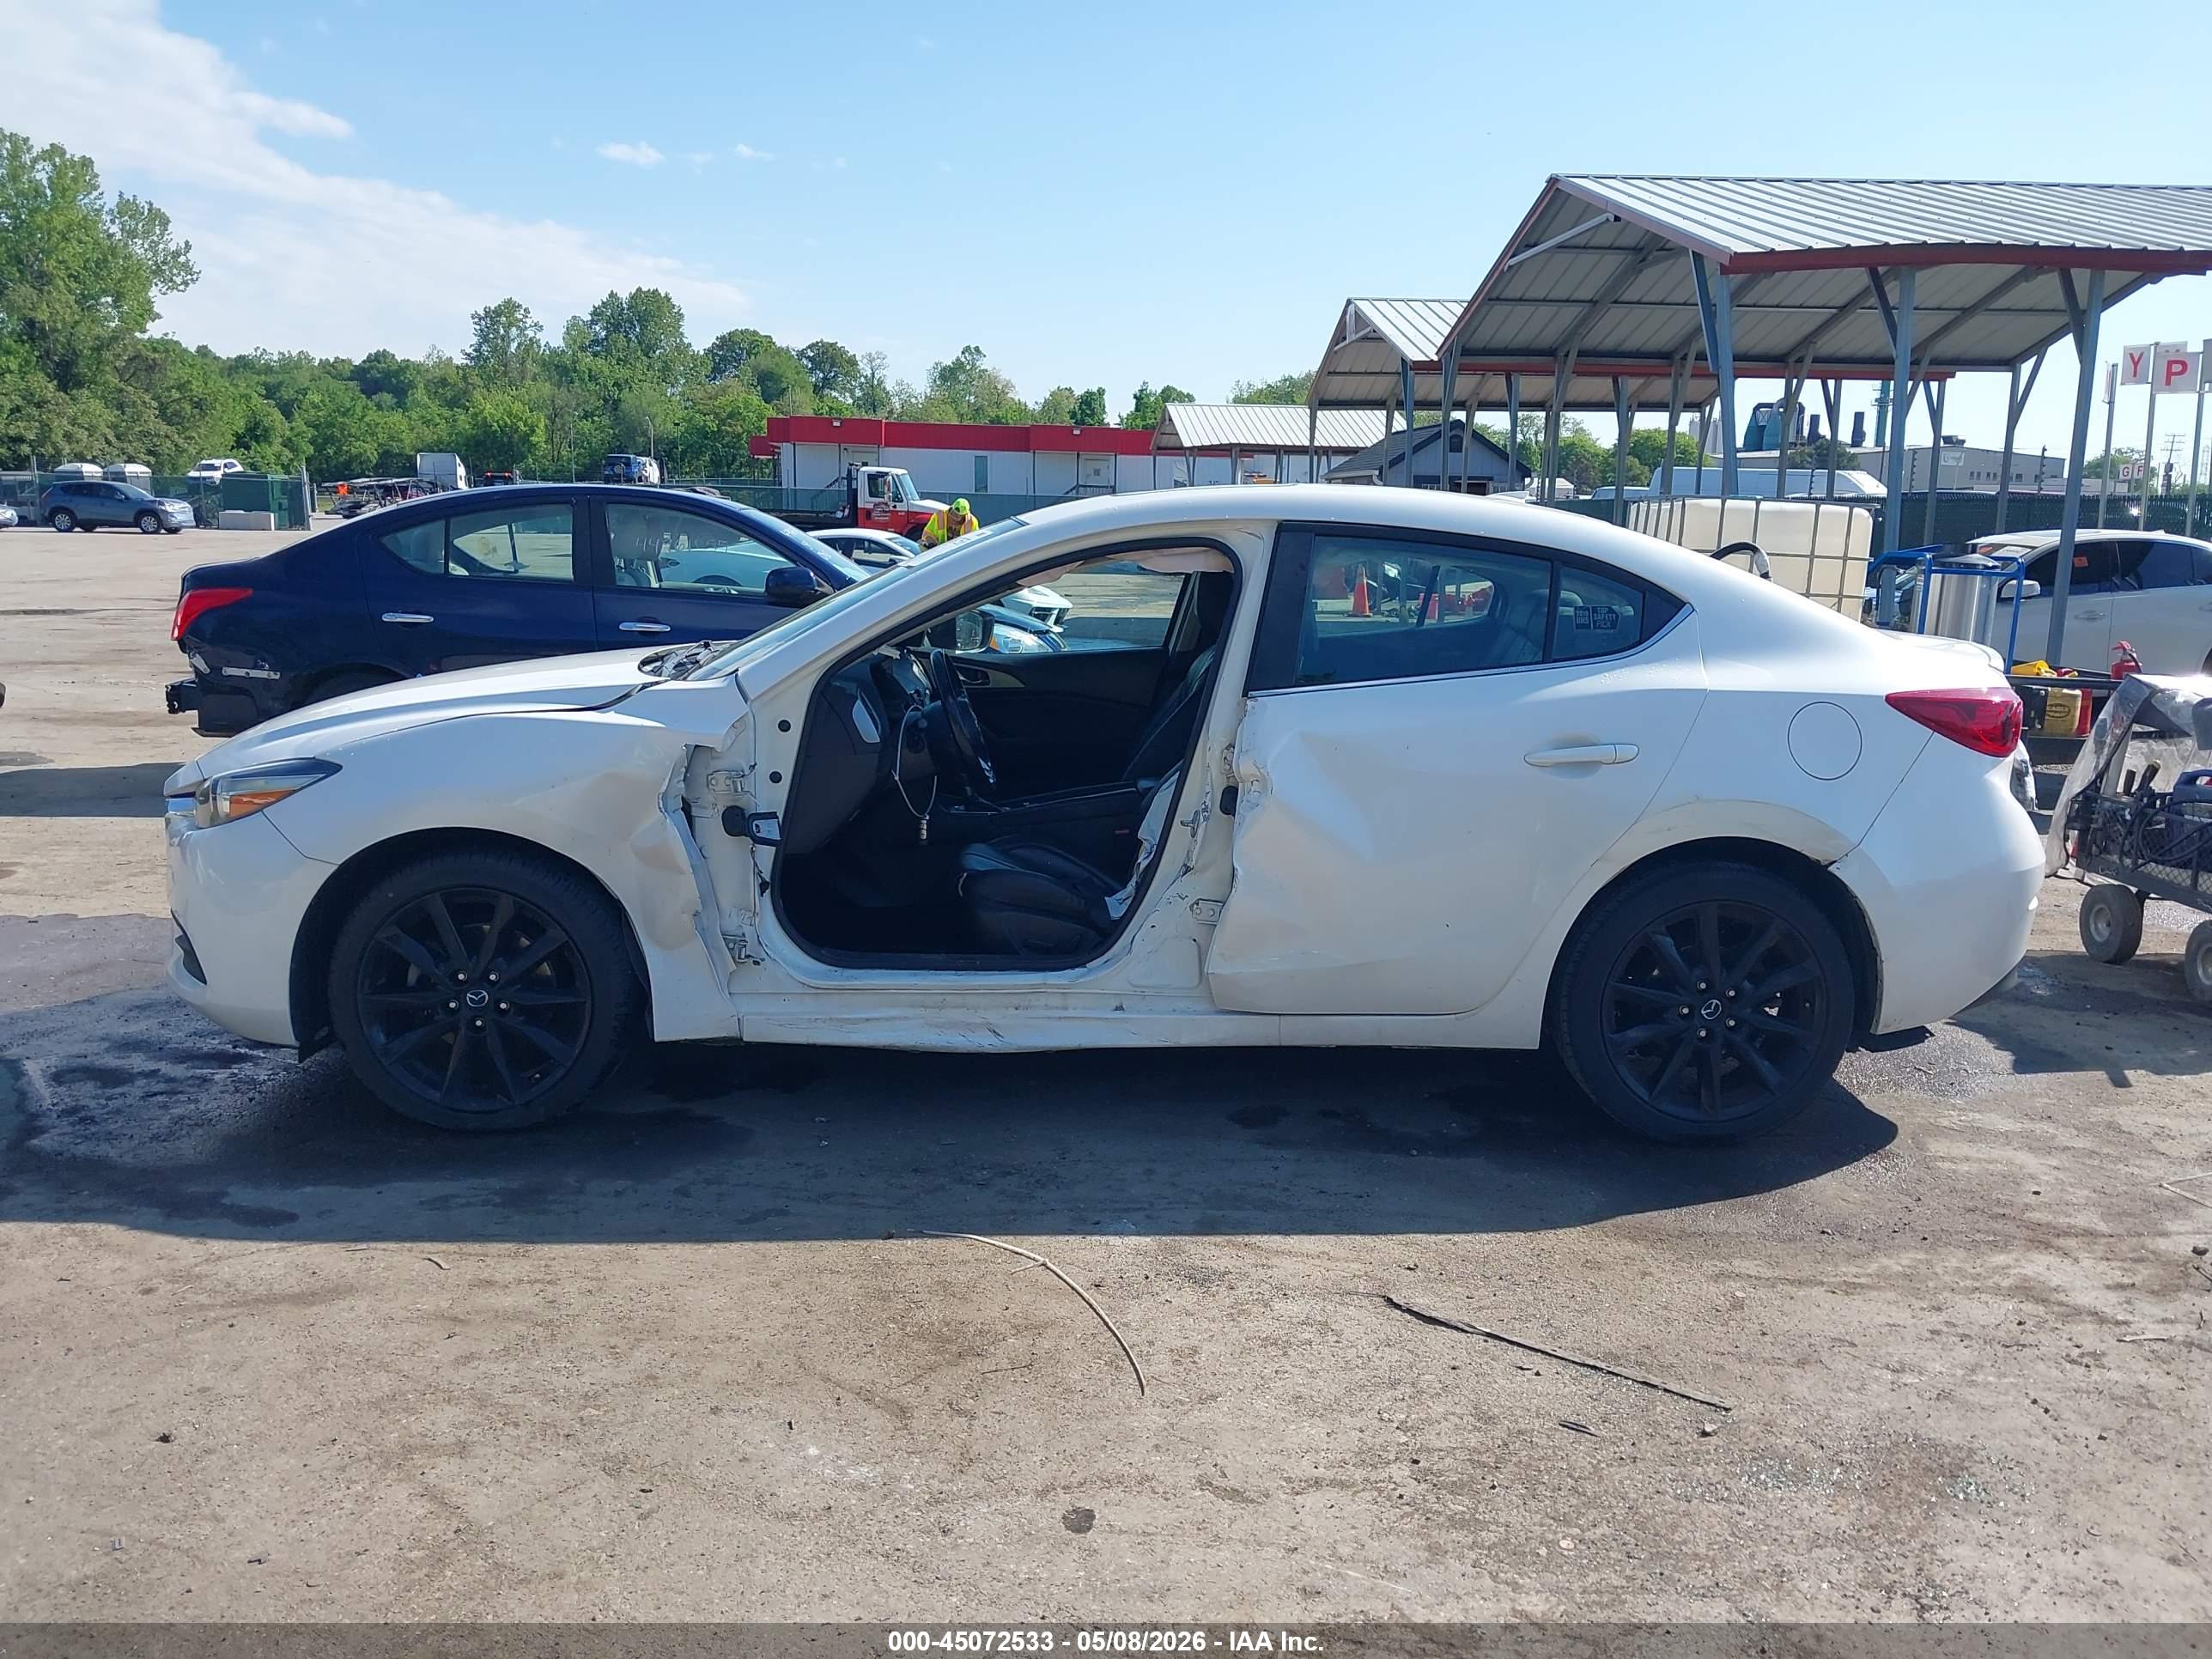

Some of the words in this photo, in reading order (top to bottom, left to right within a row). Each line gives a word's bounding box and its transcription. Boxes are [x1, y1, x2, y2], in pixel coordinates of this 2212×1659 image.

[2130, 351, 2144, 378] Y
[2165, 359, 2188, 386] P
[2122, 466, 2130, 477] G
[2137, 465, 2144, 477] F
